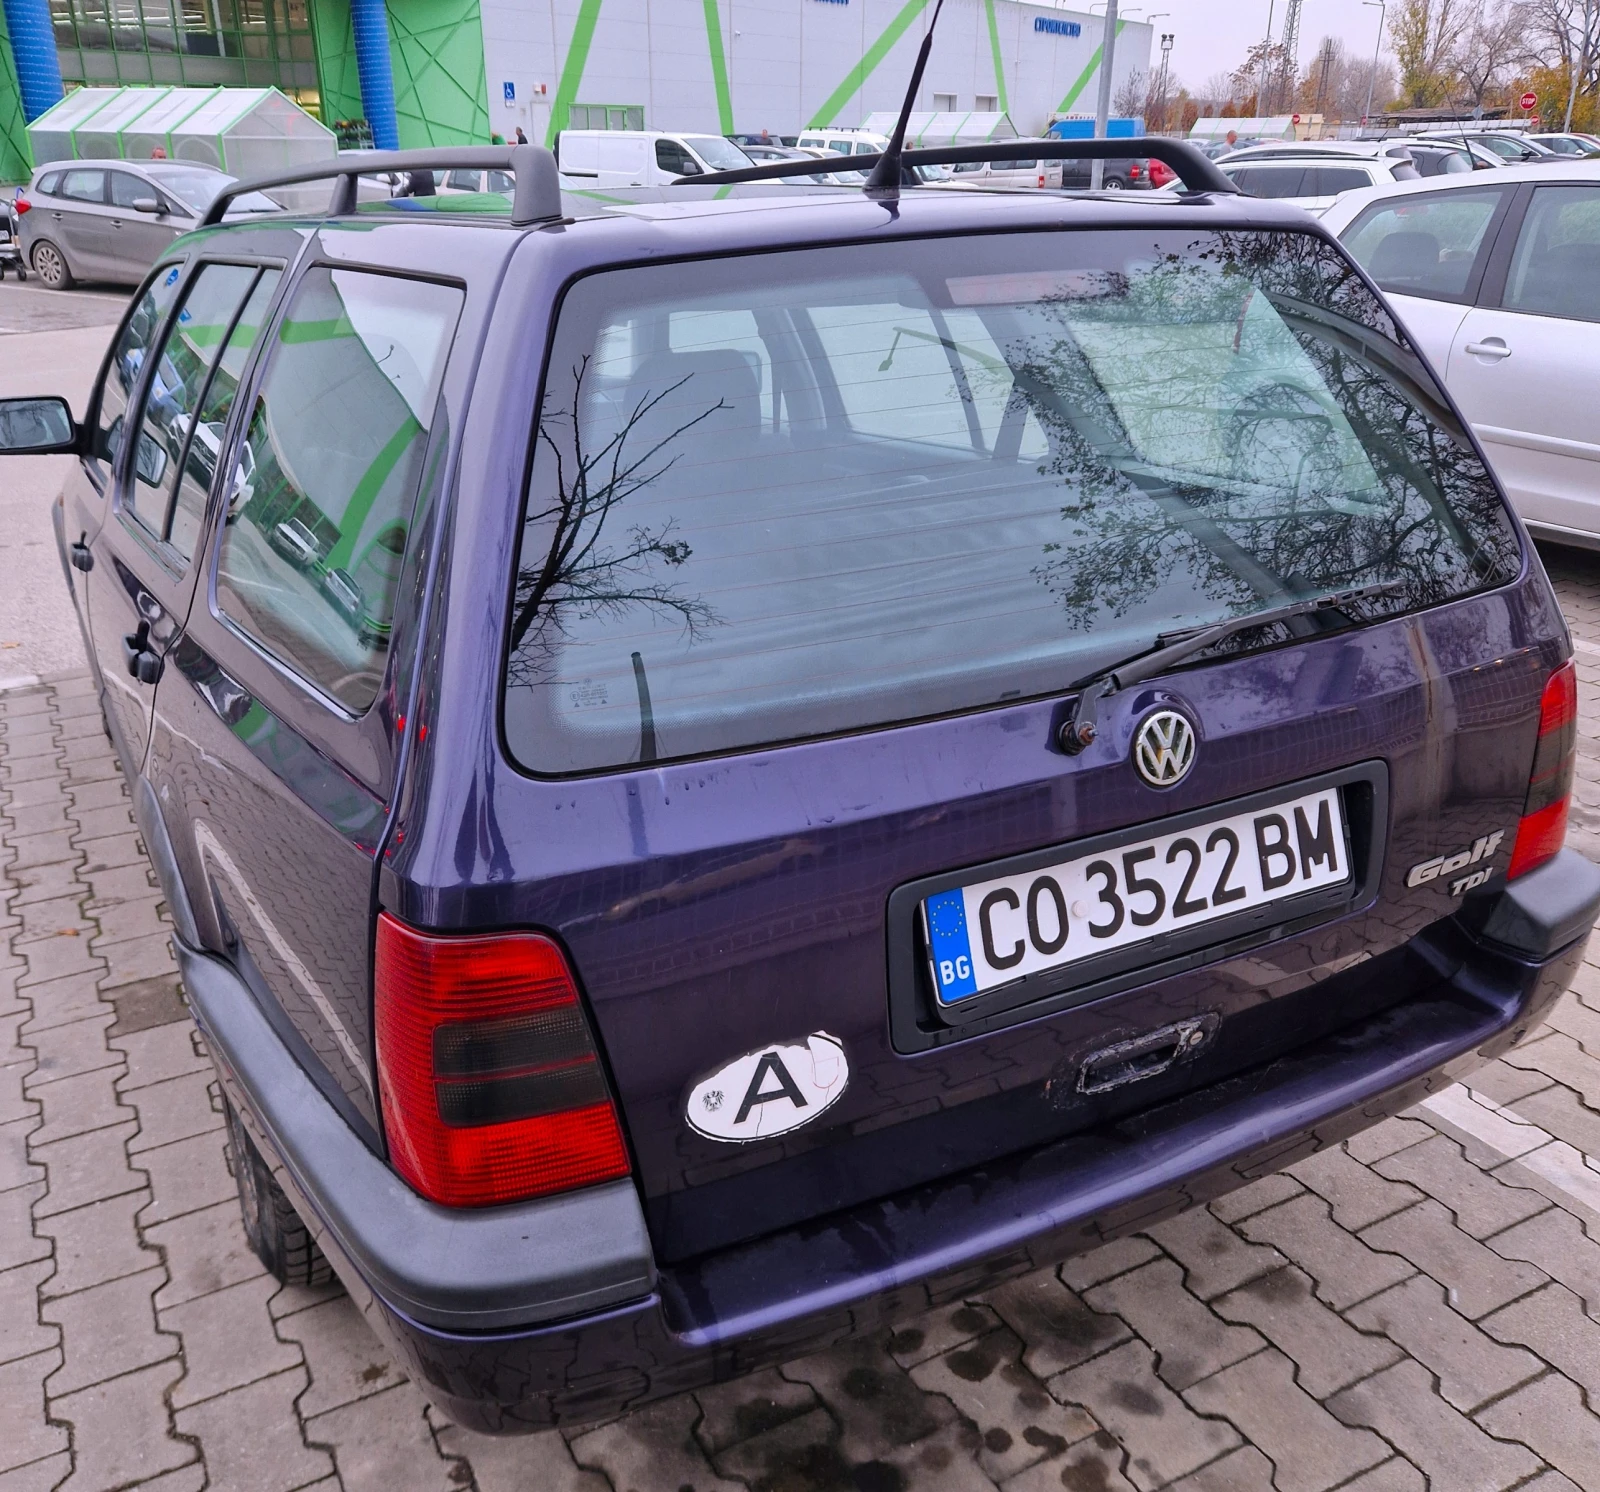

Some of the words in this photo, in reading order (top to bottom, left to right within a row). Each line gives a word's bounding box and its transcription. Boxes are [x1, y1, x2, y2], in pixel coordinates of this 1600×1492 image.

[1136, 711, 1195, 785] VW
[1085, 827, 1247, 939] 3522
[1253, 799, 1338, 891] BM
[1407, 829, 1505, 888] Golf
[939, 956, 970, 986] BG
[733, 1051, 809, 1125] A
